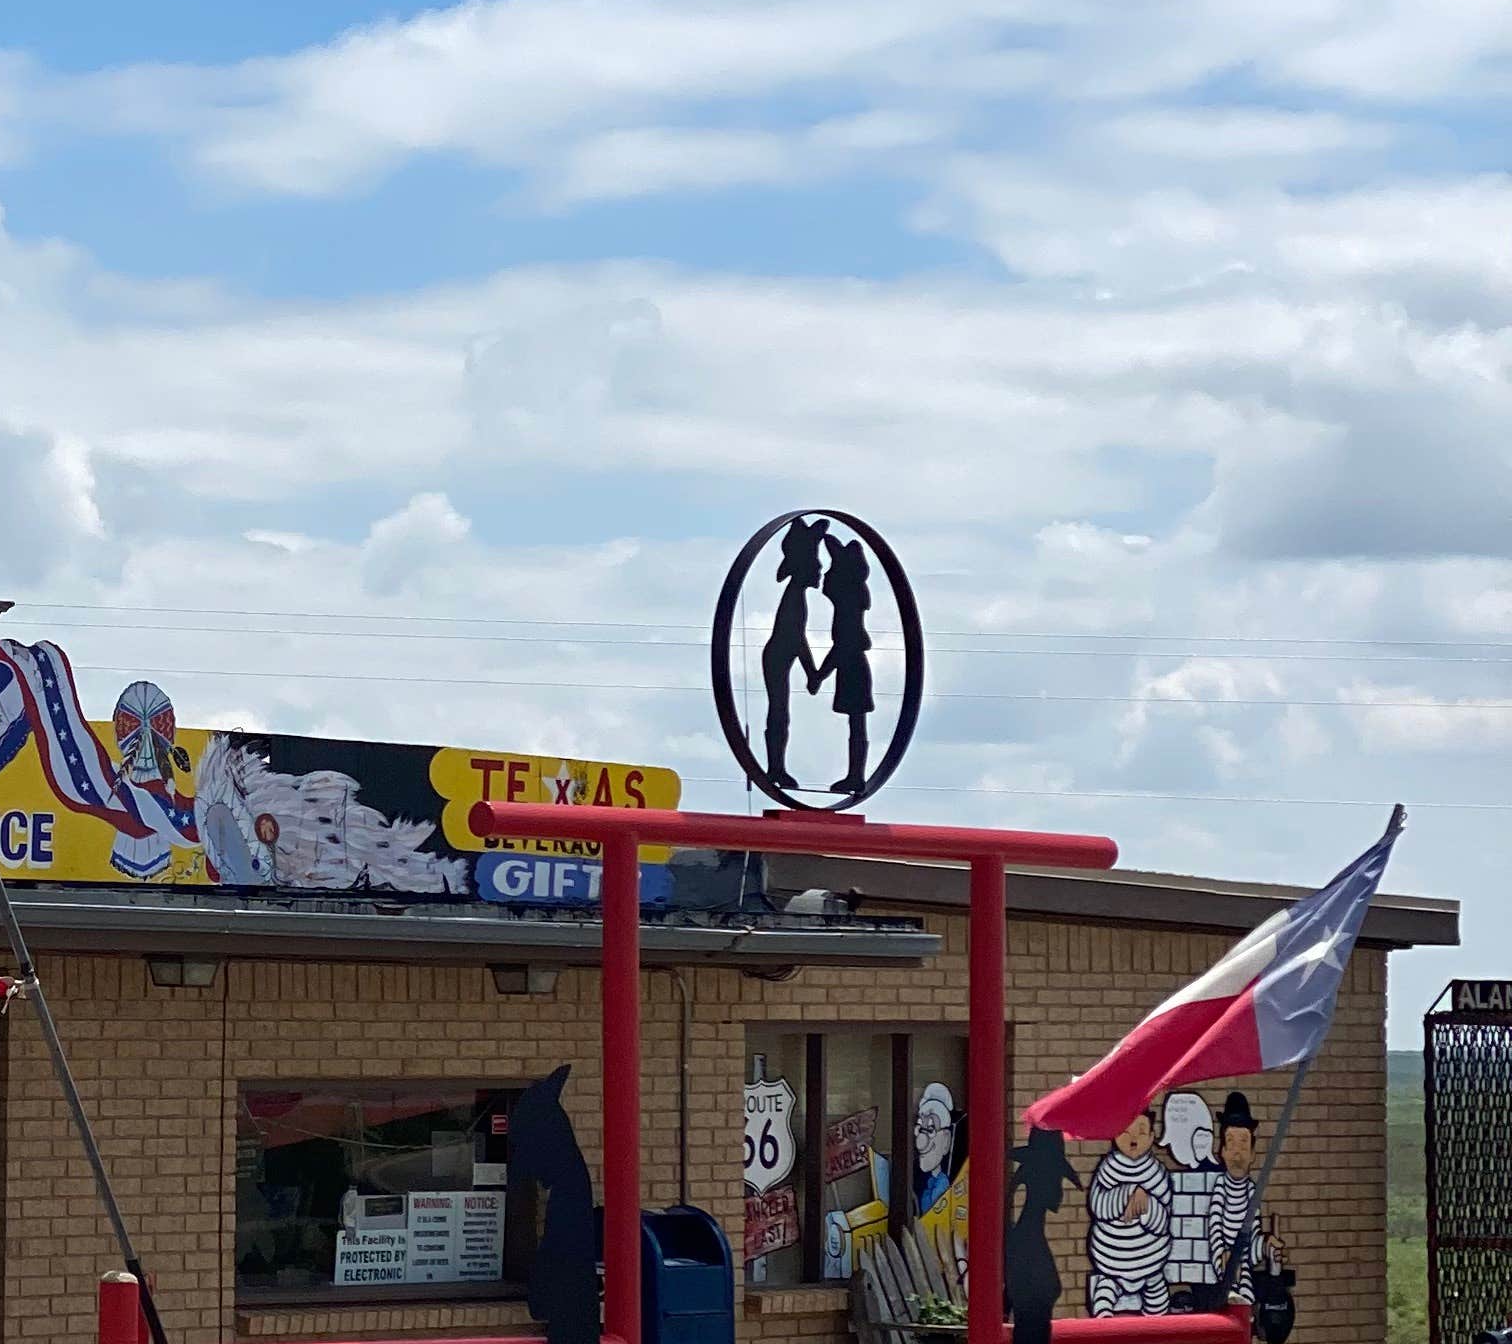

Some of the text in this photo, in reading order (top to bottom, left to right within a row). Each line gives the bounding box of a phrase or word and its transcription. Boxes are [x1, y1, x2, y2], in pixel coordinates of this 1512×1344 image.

[470, 758, 646, 808] TEXAS
[492, 859, 642, 898] GIFT
[746, 1093, 783, 1113] OUTE
[340, 1251, 392, 1265] PROTECTED
[393, 1250, 407, 1262] BY
[344, 1267, 403, 1282] ELECTRONIC
